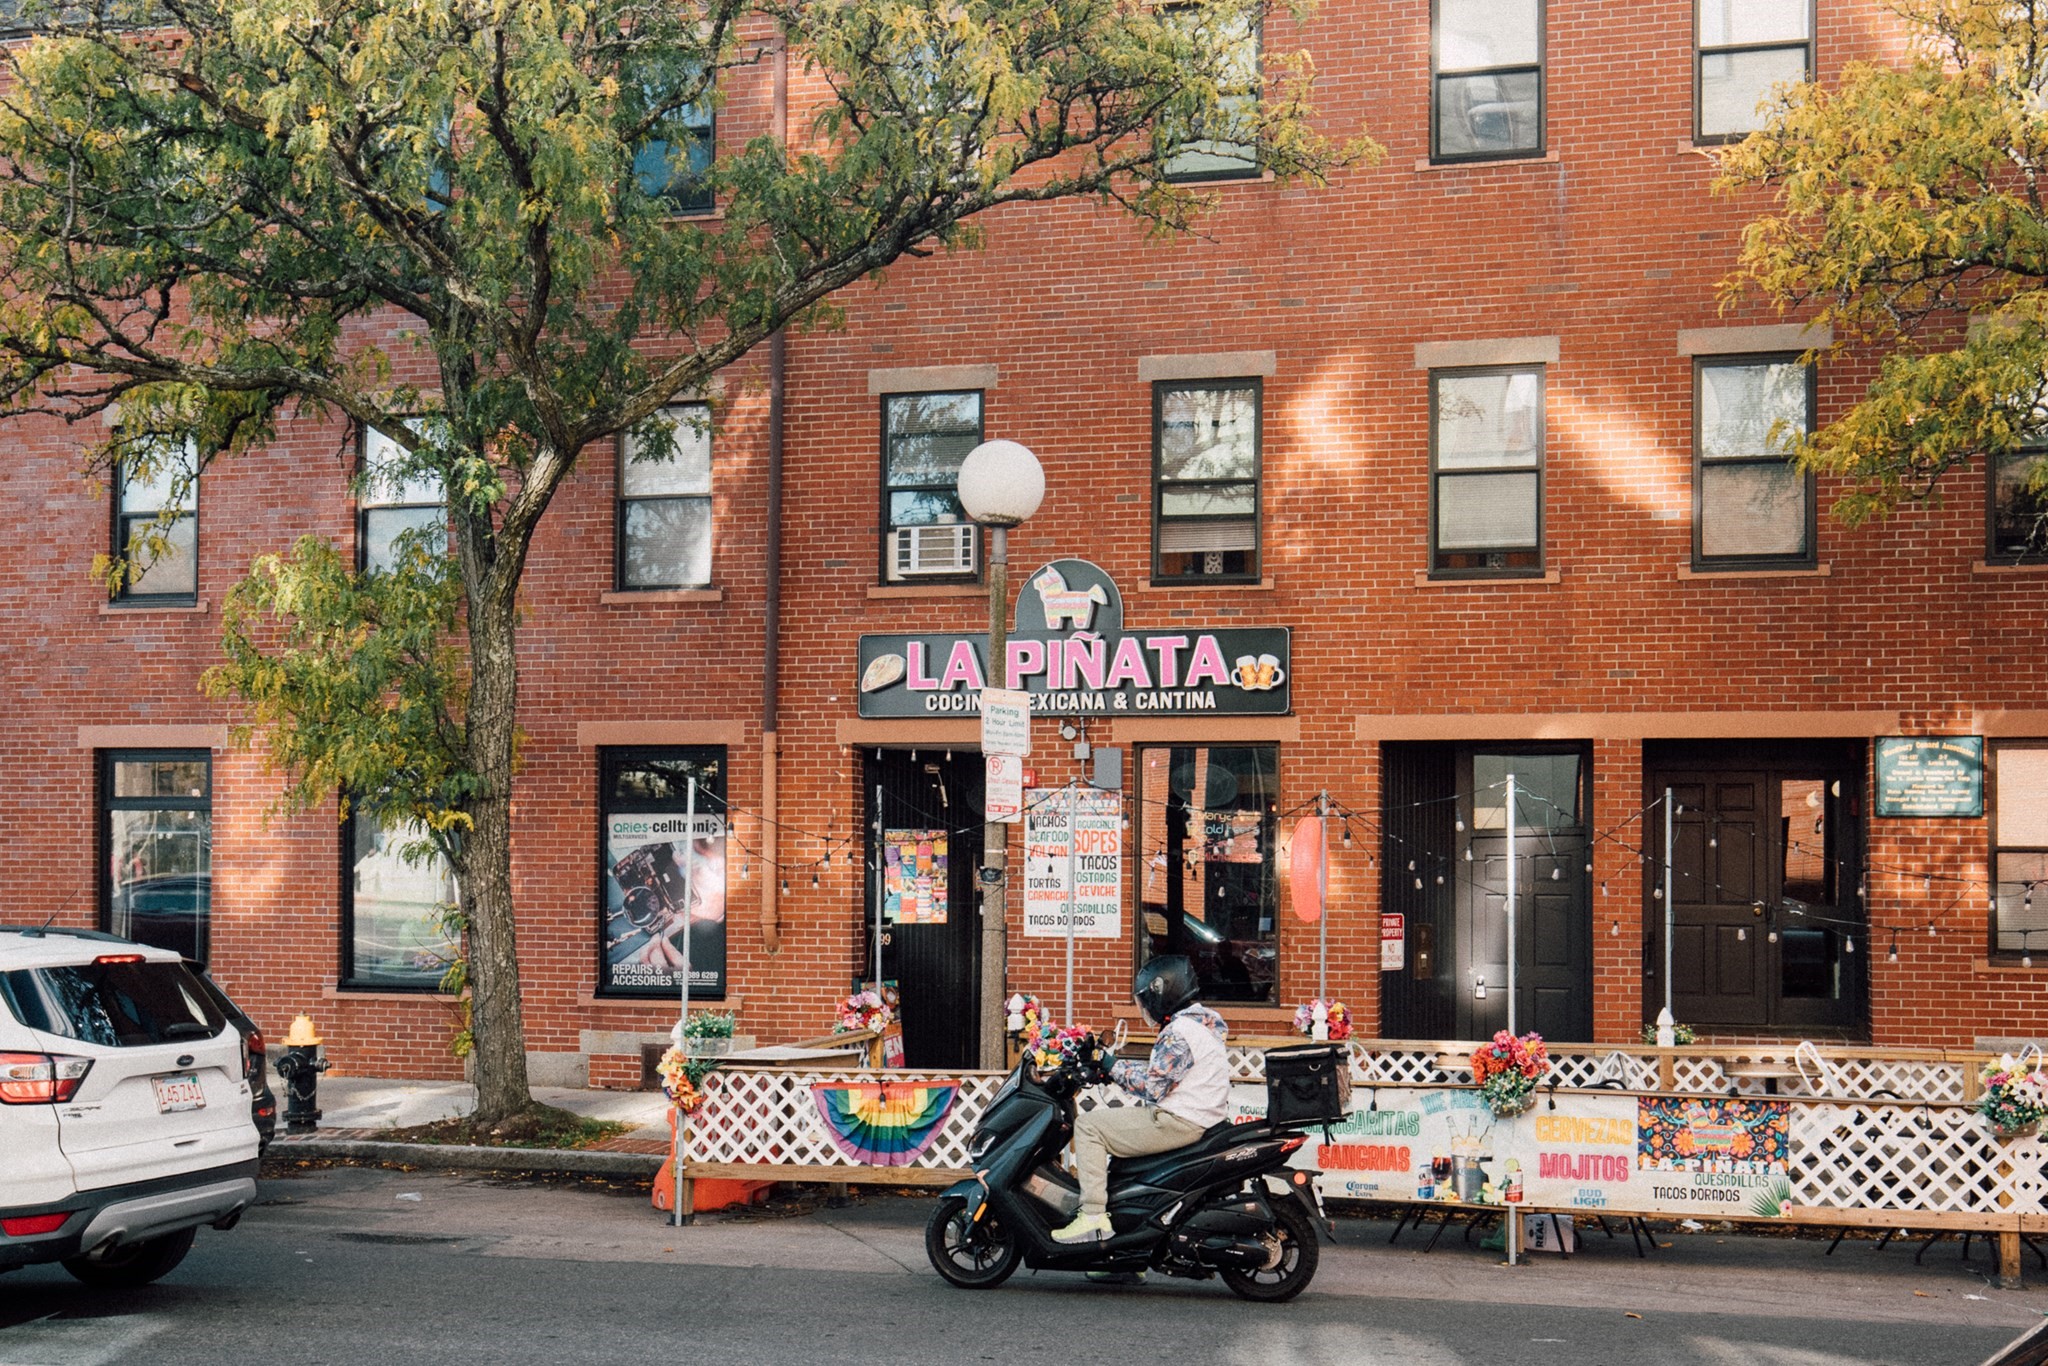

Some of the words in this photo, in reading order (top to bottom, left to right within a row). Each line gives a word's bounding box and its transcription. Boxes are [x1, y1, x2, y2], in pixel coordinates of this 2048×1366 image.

[907, 640, 986, 691] LA
[1005, 631, 1231, 690] PIÑATA
[926, 694, 982, 711] COCIN
[1029, 692, 1106, 711] EXICANA
[1114, 692, 1128, 710] &
[1135, 691, 1217, 709] CANTINA
[991, 705, 1019, 718] Parking
[1075, 829, 1118, 854] SOPES
[1080, 855, 1117, 870] TACOS
[1029, 878, 1061, 889] TORTAS
[1079, 885, 1117, 897] CEVICHE
[1029, 915, 1055, 926] TACOS
[1057, 915, 1095, 926] DOADOS
[612, 964, 654, 975] REPAIRS
[655, 965, 663, 975] &
[612, 975, 673, 986] ACCESORIES
[1536, 1115, 1633, 1145] CERVEZAS
[1317, 1143, 1411, 1172] SANGRIAS
[1540, 1153, 1629, 1182] MOJITOS
[1642, 1157, 1675, 1171] LA
[1684, 1156, 1787, 1176] PIÑATA
[1346, 1181, 1379, 1191] Corona
[1694, 1173, 1770, 1188] QUESADILLAS
[1578, 1188, 1602, 1198] BUD
[1653, 1186, 1687, 1200] TACOS
[1690, 1187, 1741, 1202] DORADOS
[1573, 1197, 1607, 1207] LIGHT
[1535, 1220, 1545, 1249] REAL
